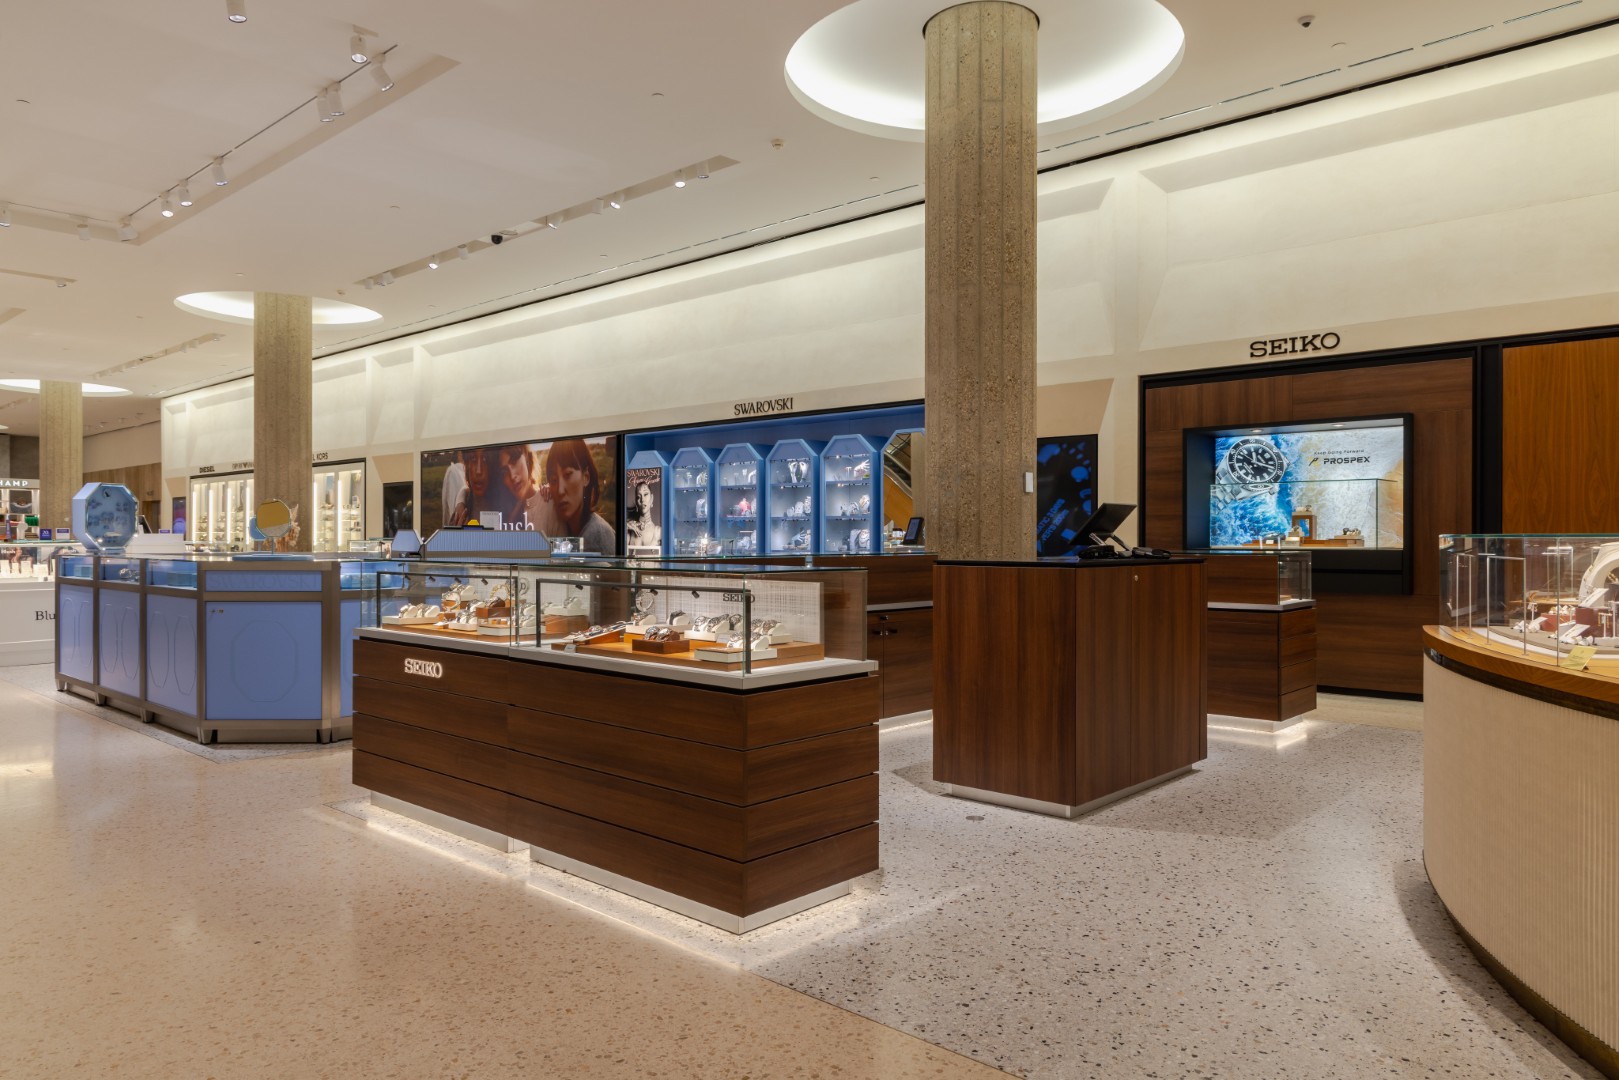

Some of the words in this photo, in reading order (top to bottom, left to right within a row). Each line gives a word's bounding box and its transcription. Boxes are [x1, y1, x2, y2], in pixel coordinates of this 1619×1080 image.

[1249, 332, 1341, 358] SEIKO
[734, 397, 793, 415] SWAROVSKI
[316, 452, 329, 461] KORS
[1323, 456, 1371, 465] PROSPEX
[199, 465, 215, 473] DIESEL
[627, 468, 661, 477] SWAROVSKI
[404, 658, 443, 678] SEIKO
